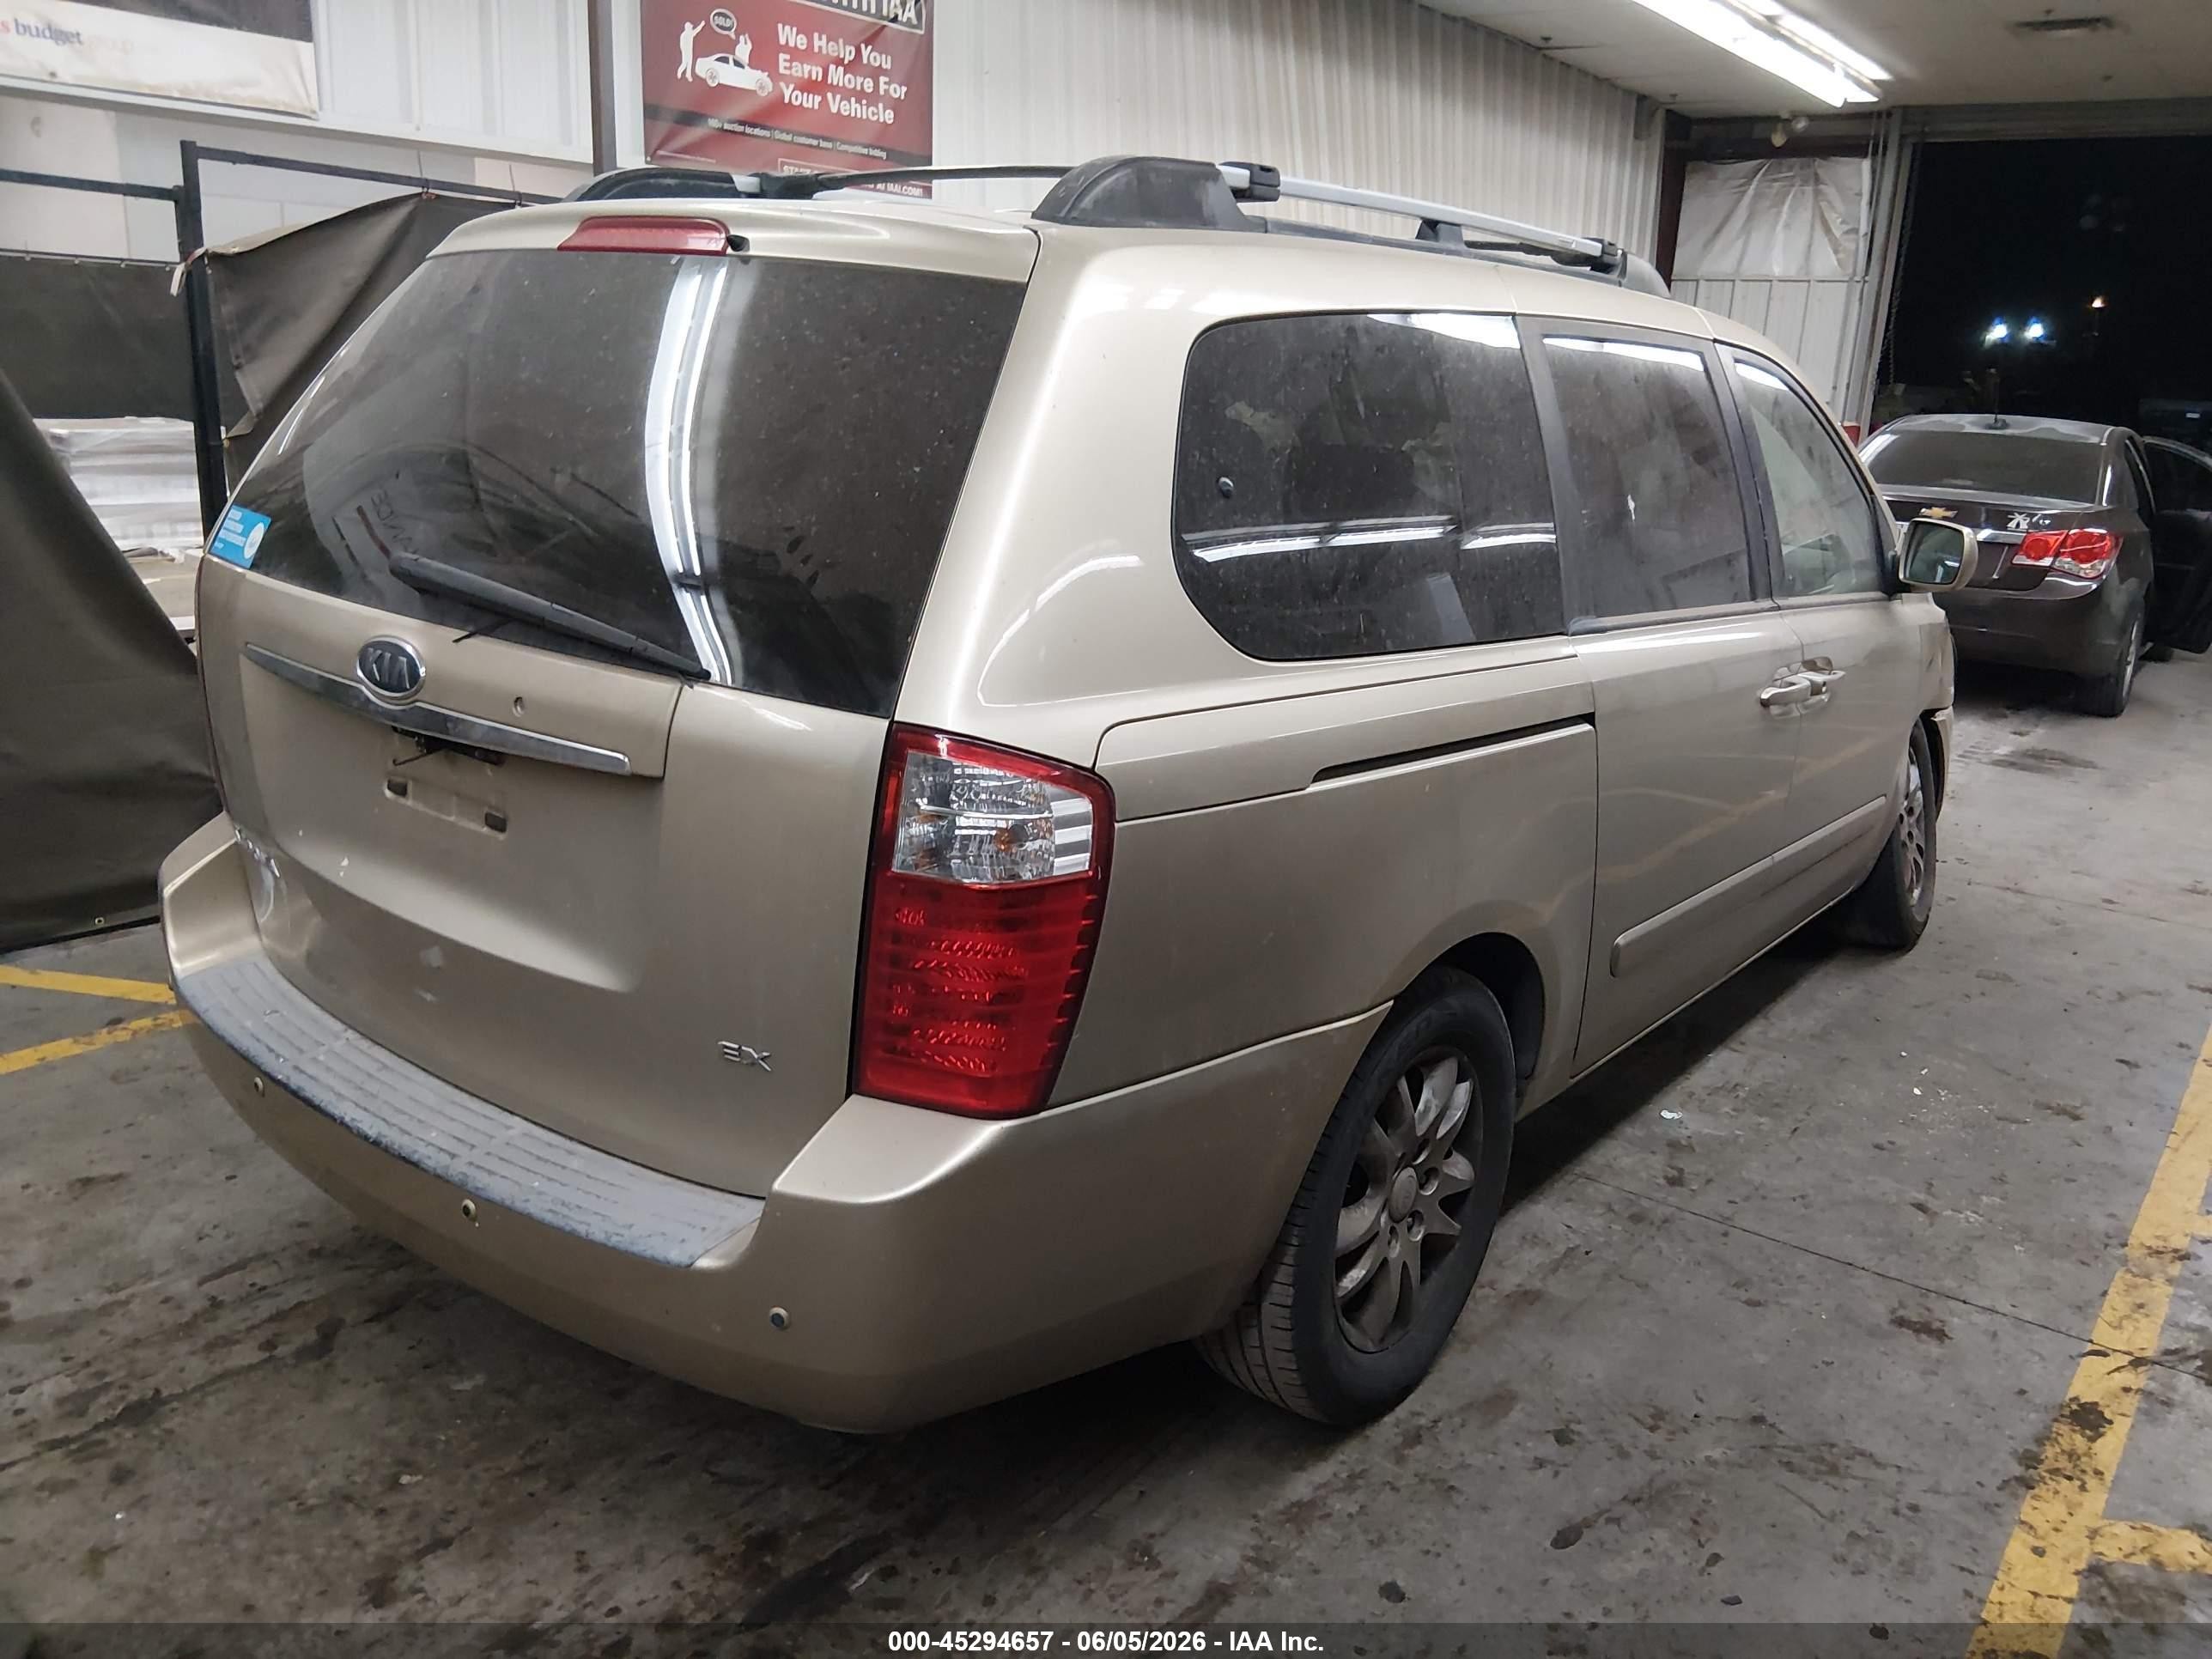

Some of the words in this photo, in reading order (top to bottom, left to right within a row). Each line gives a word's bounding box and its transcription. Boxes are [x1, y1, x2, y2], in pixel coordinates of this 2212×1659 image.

[14, 18, 83, 46] budget
[777, 22, 808, 51] We
[813, 32, 856, 64] Help
[860, 43, 892, 70] You
[778, 52, 823, 82] Earn
[827, 64, 874, 94] More
[879, 76, 908, 100] For
[779, 82, 823, 110] Your
[827, 92, 895, 125] Vehicle
[744, 124, 771, 138] locations
[364, 647, 410, 690] KIA
[718, 1041, 772, 1072] EX
